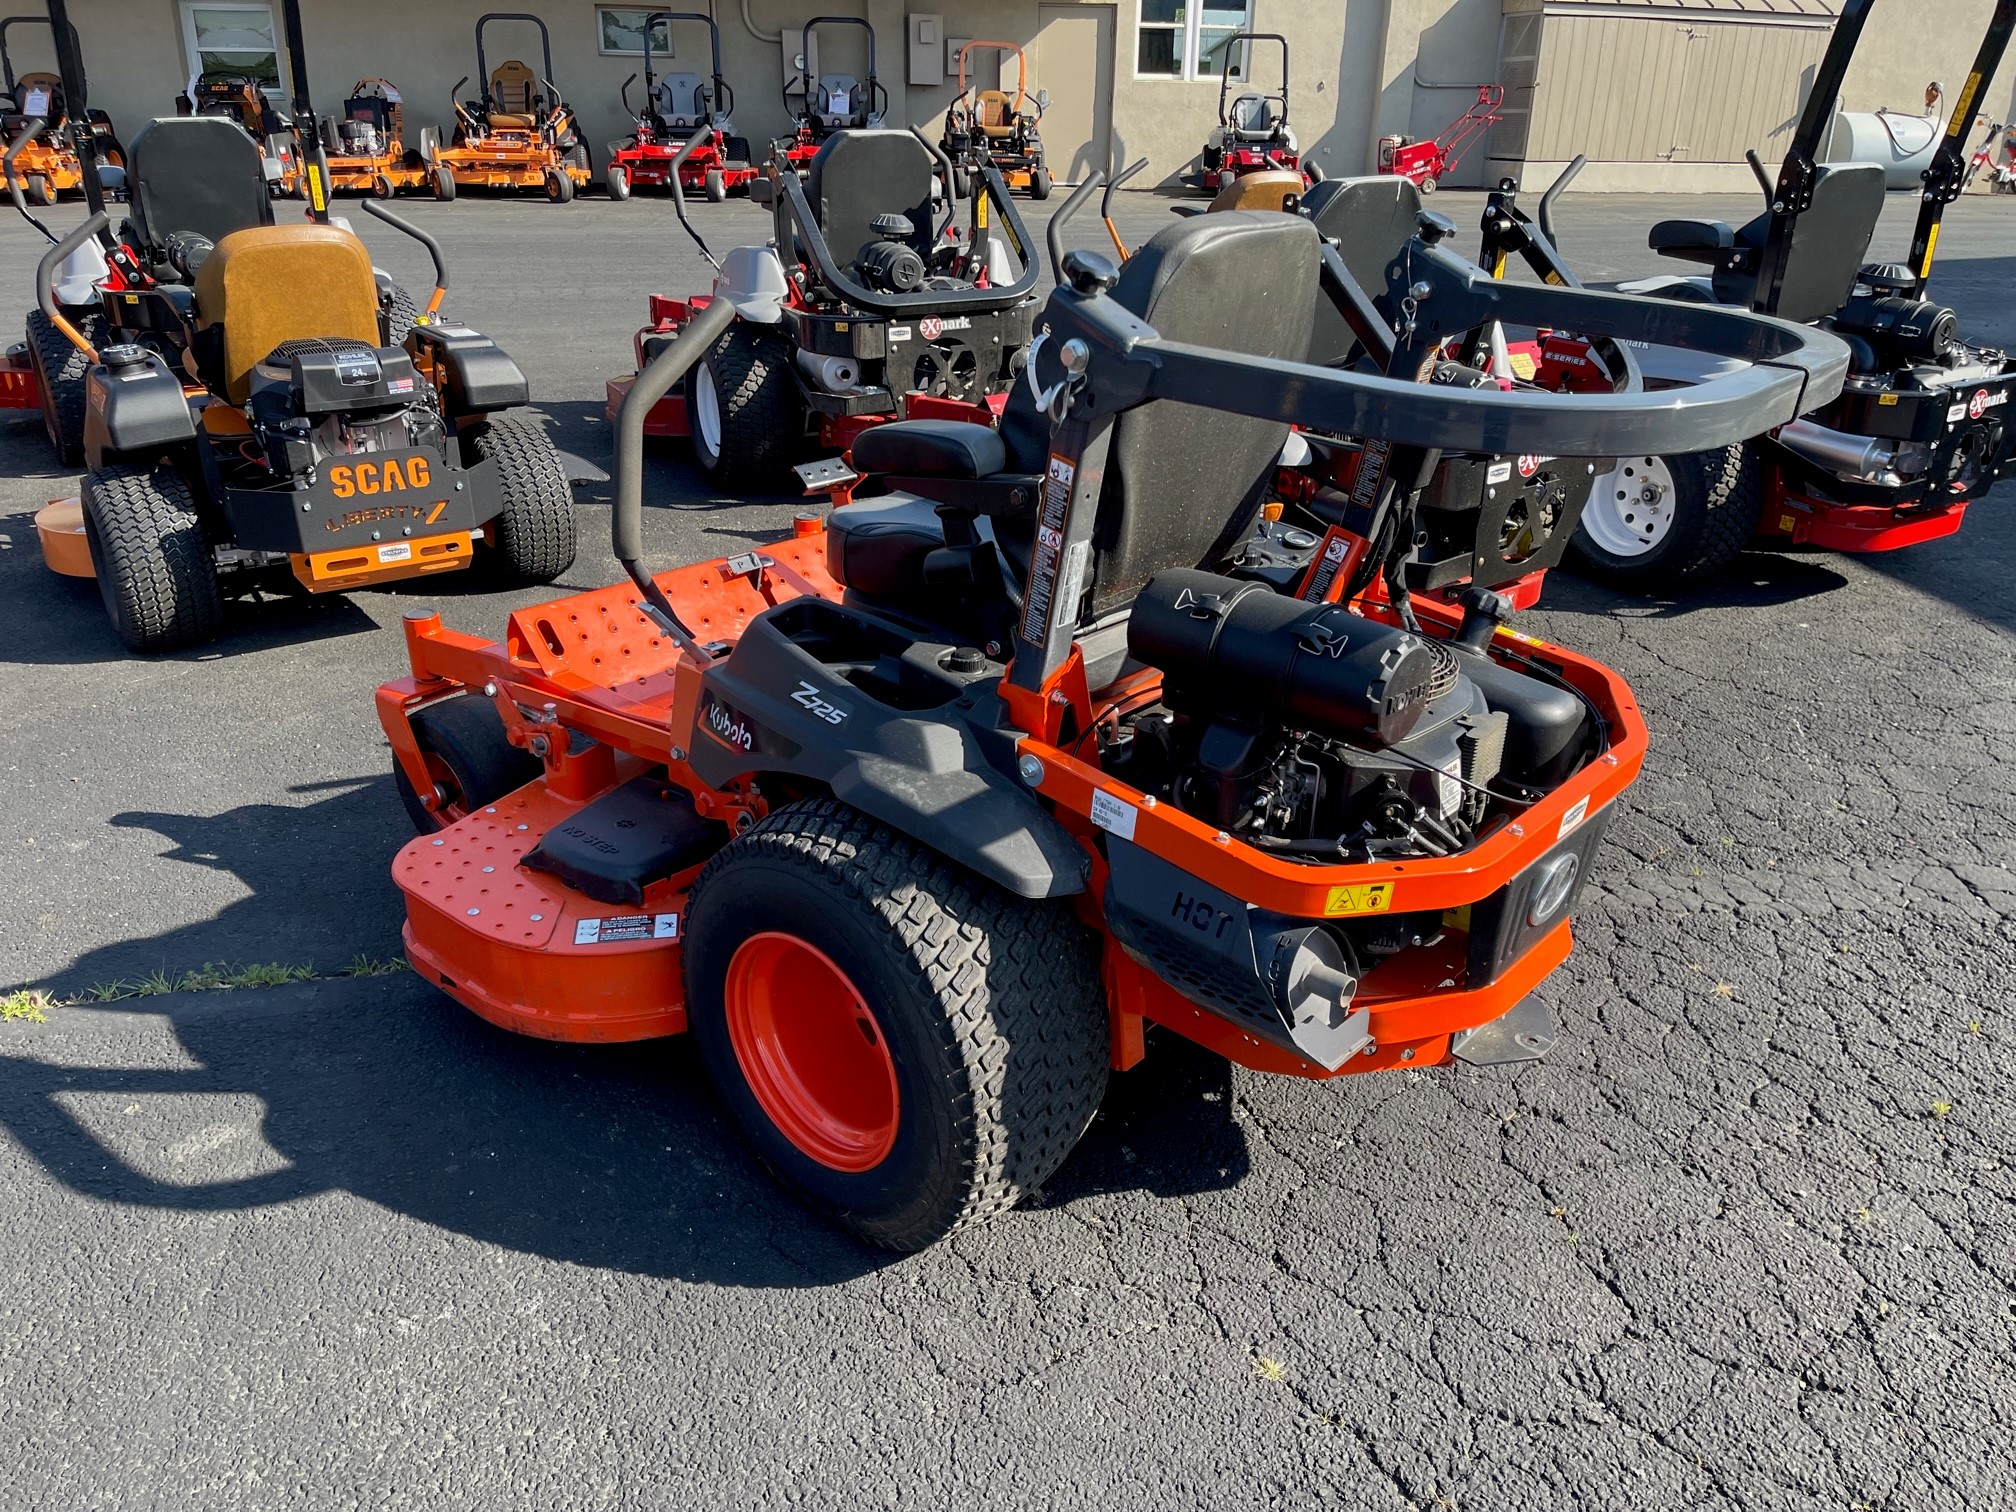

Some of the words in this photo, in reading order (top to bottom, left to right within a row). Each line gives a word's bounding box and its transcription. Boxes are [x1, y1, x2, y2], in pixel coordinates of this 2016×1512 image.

[329, 455, 431, 499] SCAG
[709, 703, 752, 750] Kubota
[1171, 891, 1234, 939] HOT
[1268, 935, 1292, 998] HOT
